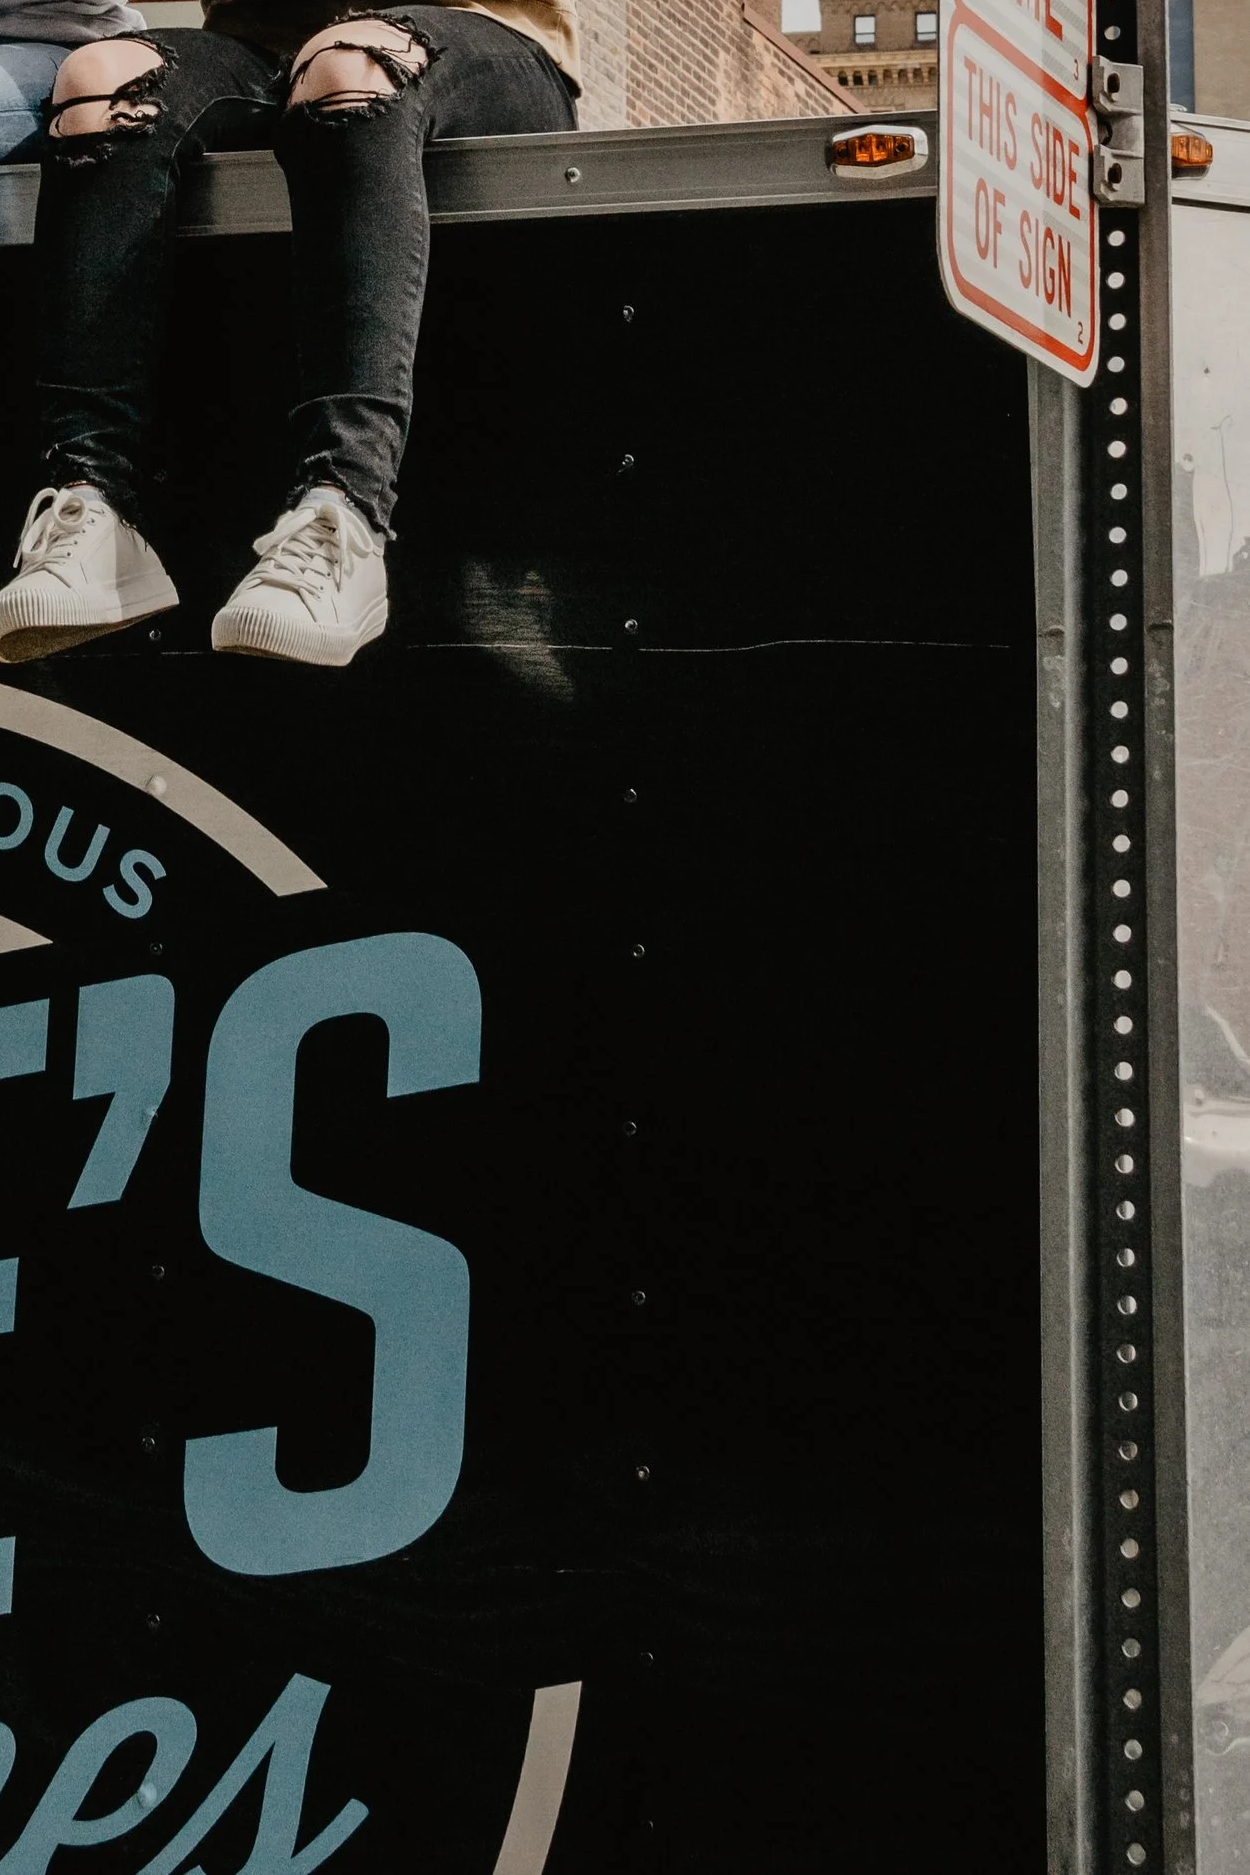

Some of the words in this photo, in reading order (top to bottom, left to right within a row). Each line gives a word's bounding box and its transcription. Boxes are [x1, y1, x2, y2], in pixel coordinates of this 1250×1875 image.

[963, 54, 1018, 172] THIS
[1030, 111, 1081, 221] SIDE
[974, 177, 1006, 269] OF
[1018, 215, 1071, 319] SIGN
